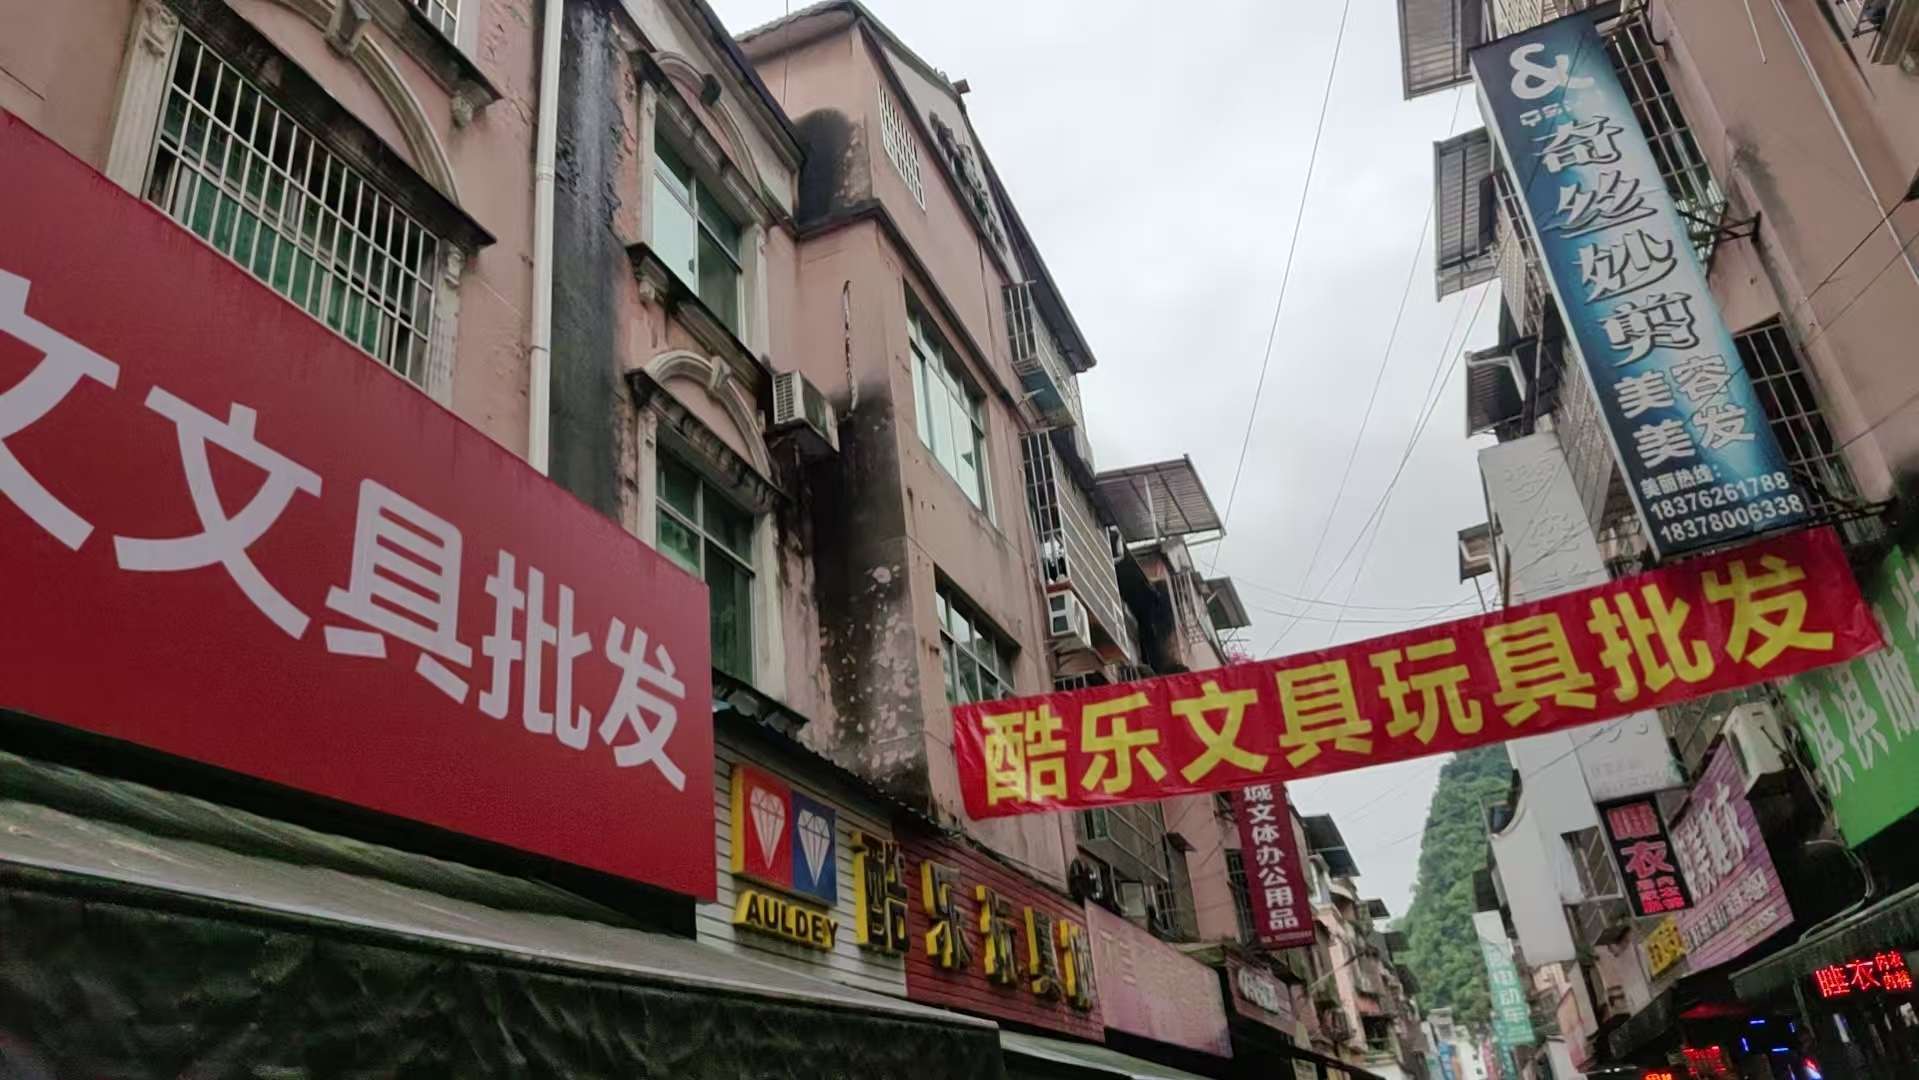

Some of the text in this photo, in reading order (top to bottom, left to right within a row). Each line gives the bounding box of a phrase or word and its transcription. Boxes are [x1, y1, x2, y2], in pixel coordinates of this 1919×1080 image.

[1530, 115, 1700, 368] 奇丝妙剪
[1614, 355, 1731, 419] 美容
[1633, 404, 1755, 468] 美发
[1650, 471, 1790, 521] 18376261788
[1660, 494, 1804, 544] 18378006338
[982, 555, 1834, 806] 酷乐文具玩具批发
[741, 890, 838, 947] AULDEY
